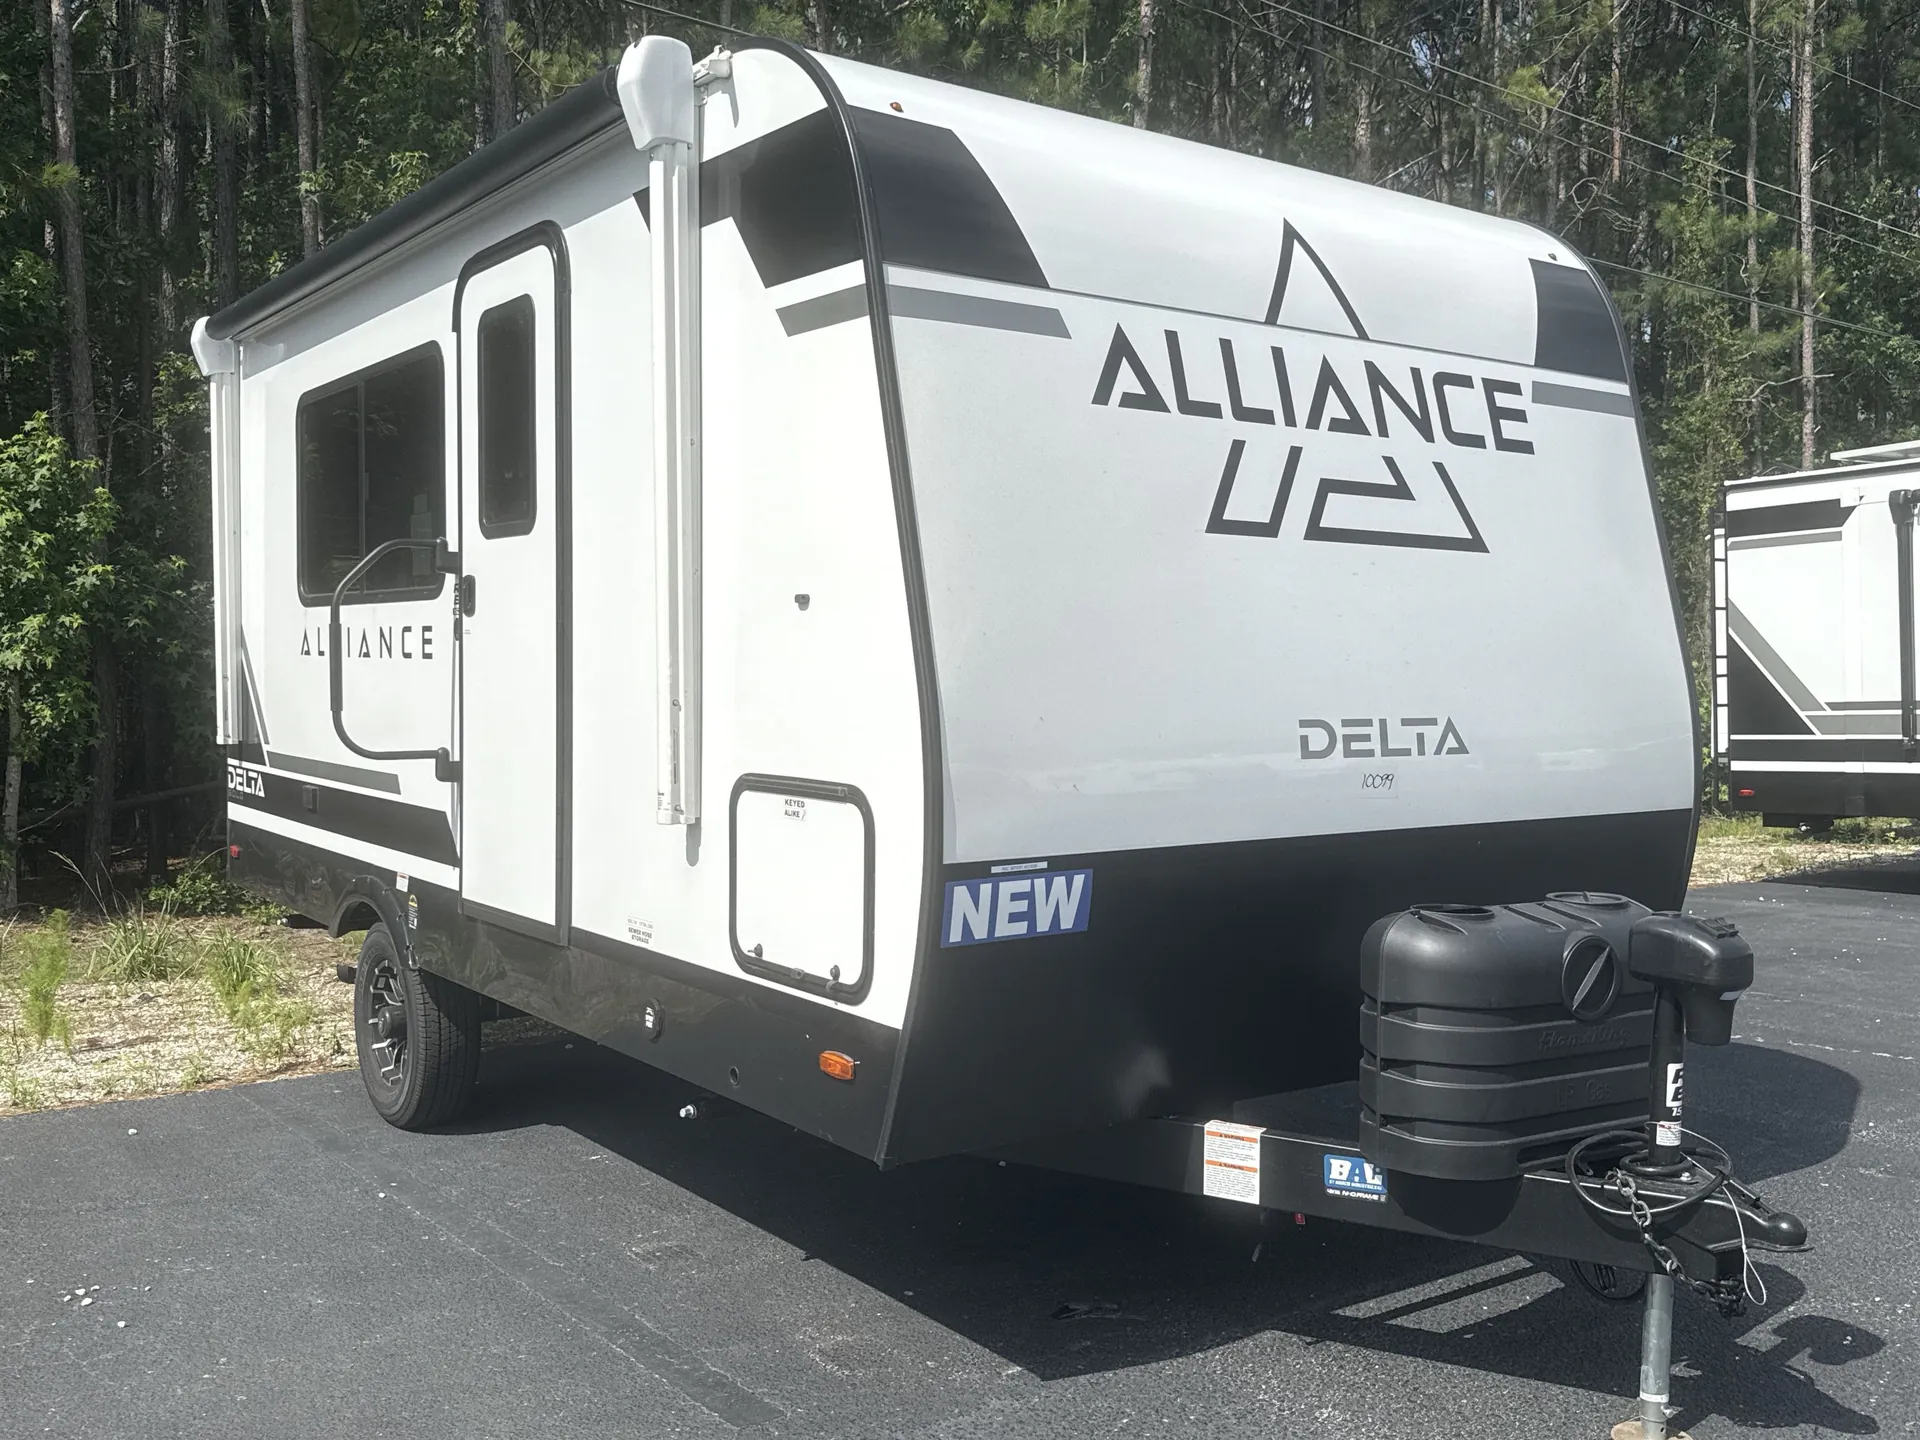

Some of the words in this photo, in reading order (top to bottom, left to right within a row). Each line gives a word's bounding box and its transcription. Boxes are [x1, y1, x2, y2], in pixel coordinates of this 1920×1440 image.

[1091, 323, 1535, 455] ALLIANCE
[300, 625, 433, 659] ALIANCE
[1298, 716, 1470, 759] DELTA
[227, 766, 265, 798] DELTA
[1361, 773, 1395, 790] 10099
[784, 798, 805, 808] KEYED
[784, 809, 800, 818] ALIKE
[949, 874, 1085, 943] NEW
[631, 934, 649, 944] STORAGE
[1329, 1158, 1383, 1185] BAL
